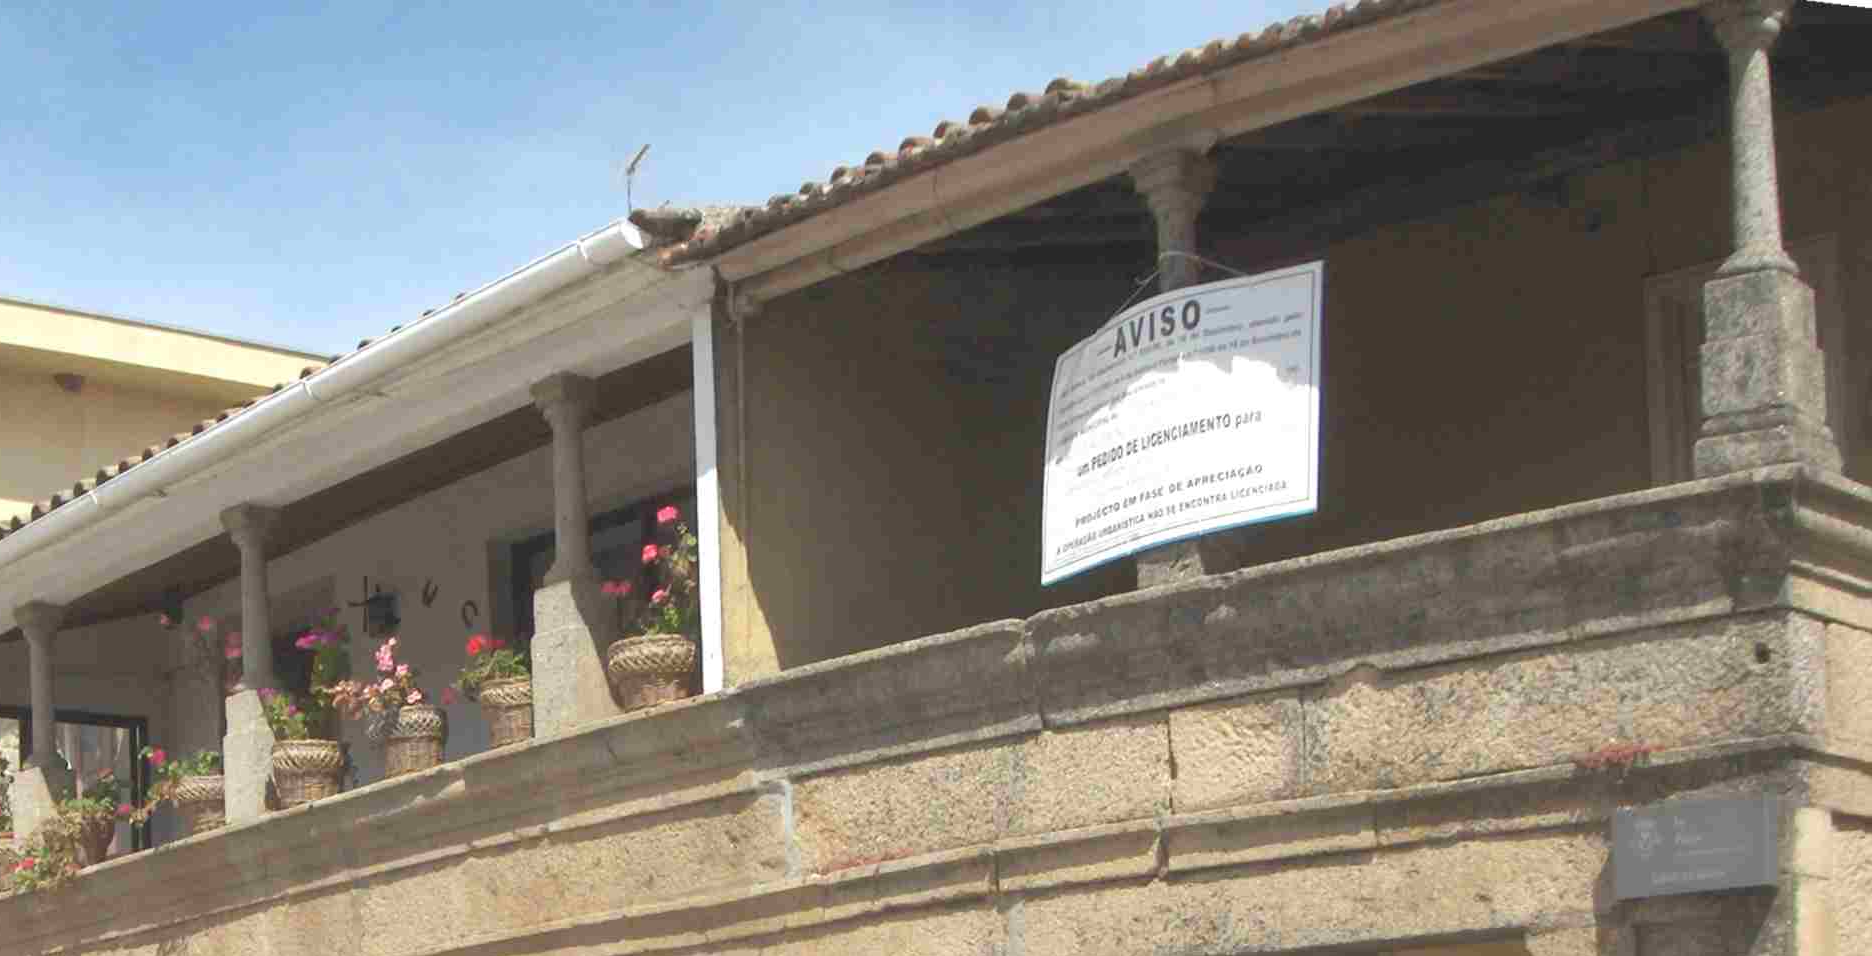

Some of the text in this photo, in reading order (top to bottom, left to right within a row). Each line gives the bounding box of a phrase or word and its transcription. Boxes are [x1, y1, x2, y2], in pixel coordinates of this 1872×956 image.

[1114, 299, 1201, 359] AVISO
[1090, 445, 1124, 471] PEDIDO
[1126, 439, 1139, 456] DE
[1141, 413, 1232, 451] LICENCIAMENTO
[1235, 410, 1263, 429] para
[1139, 486, 1164, 503] FASE
[1168, 482, 1184, 494] DE
